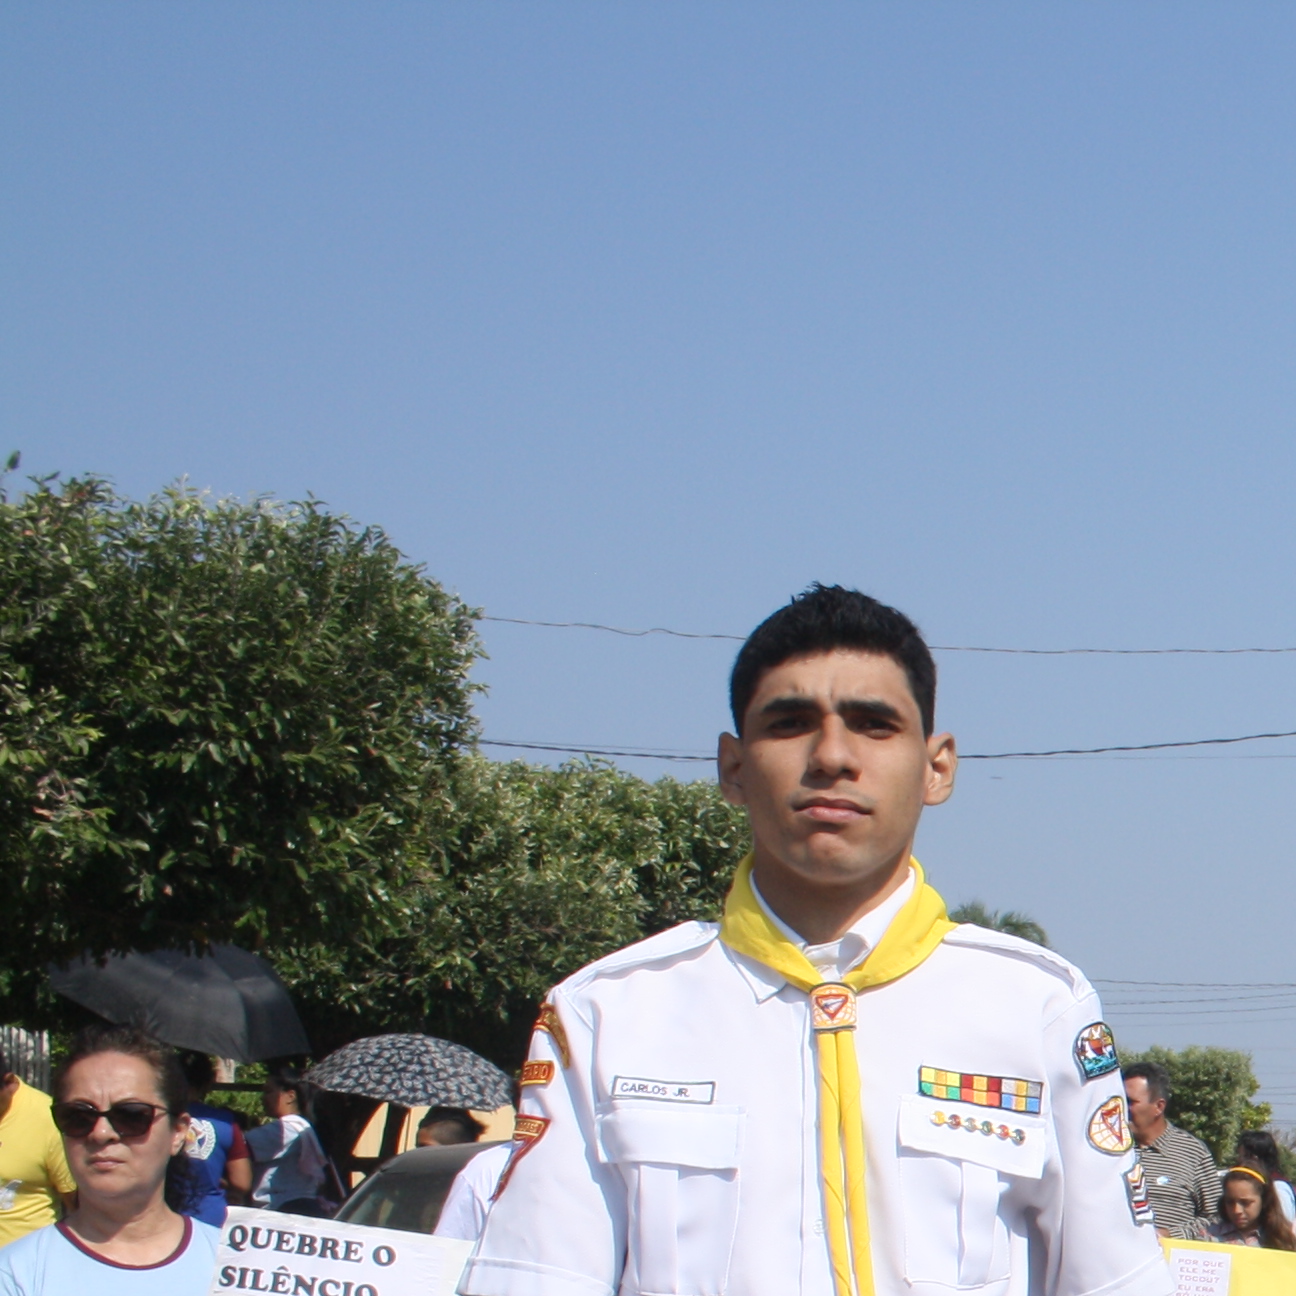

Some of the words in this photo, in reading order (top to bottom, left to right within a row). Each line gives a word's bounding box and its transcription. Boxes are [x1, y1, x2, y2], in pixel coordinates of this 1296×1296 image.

[620, 1081, 668, 1096] CARLOS
[227, 1224, 364, 1263] QUEBRE
[372, 1245, 397, 1267] O
[1178, 1258, 1199, 1266] POR
[1203, 1259, 1224, 1268] QUE
[1178, 1274, 1220, 1283] TOCOU?
[1195, 1285, 1215, 1293] ERA
